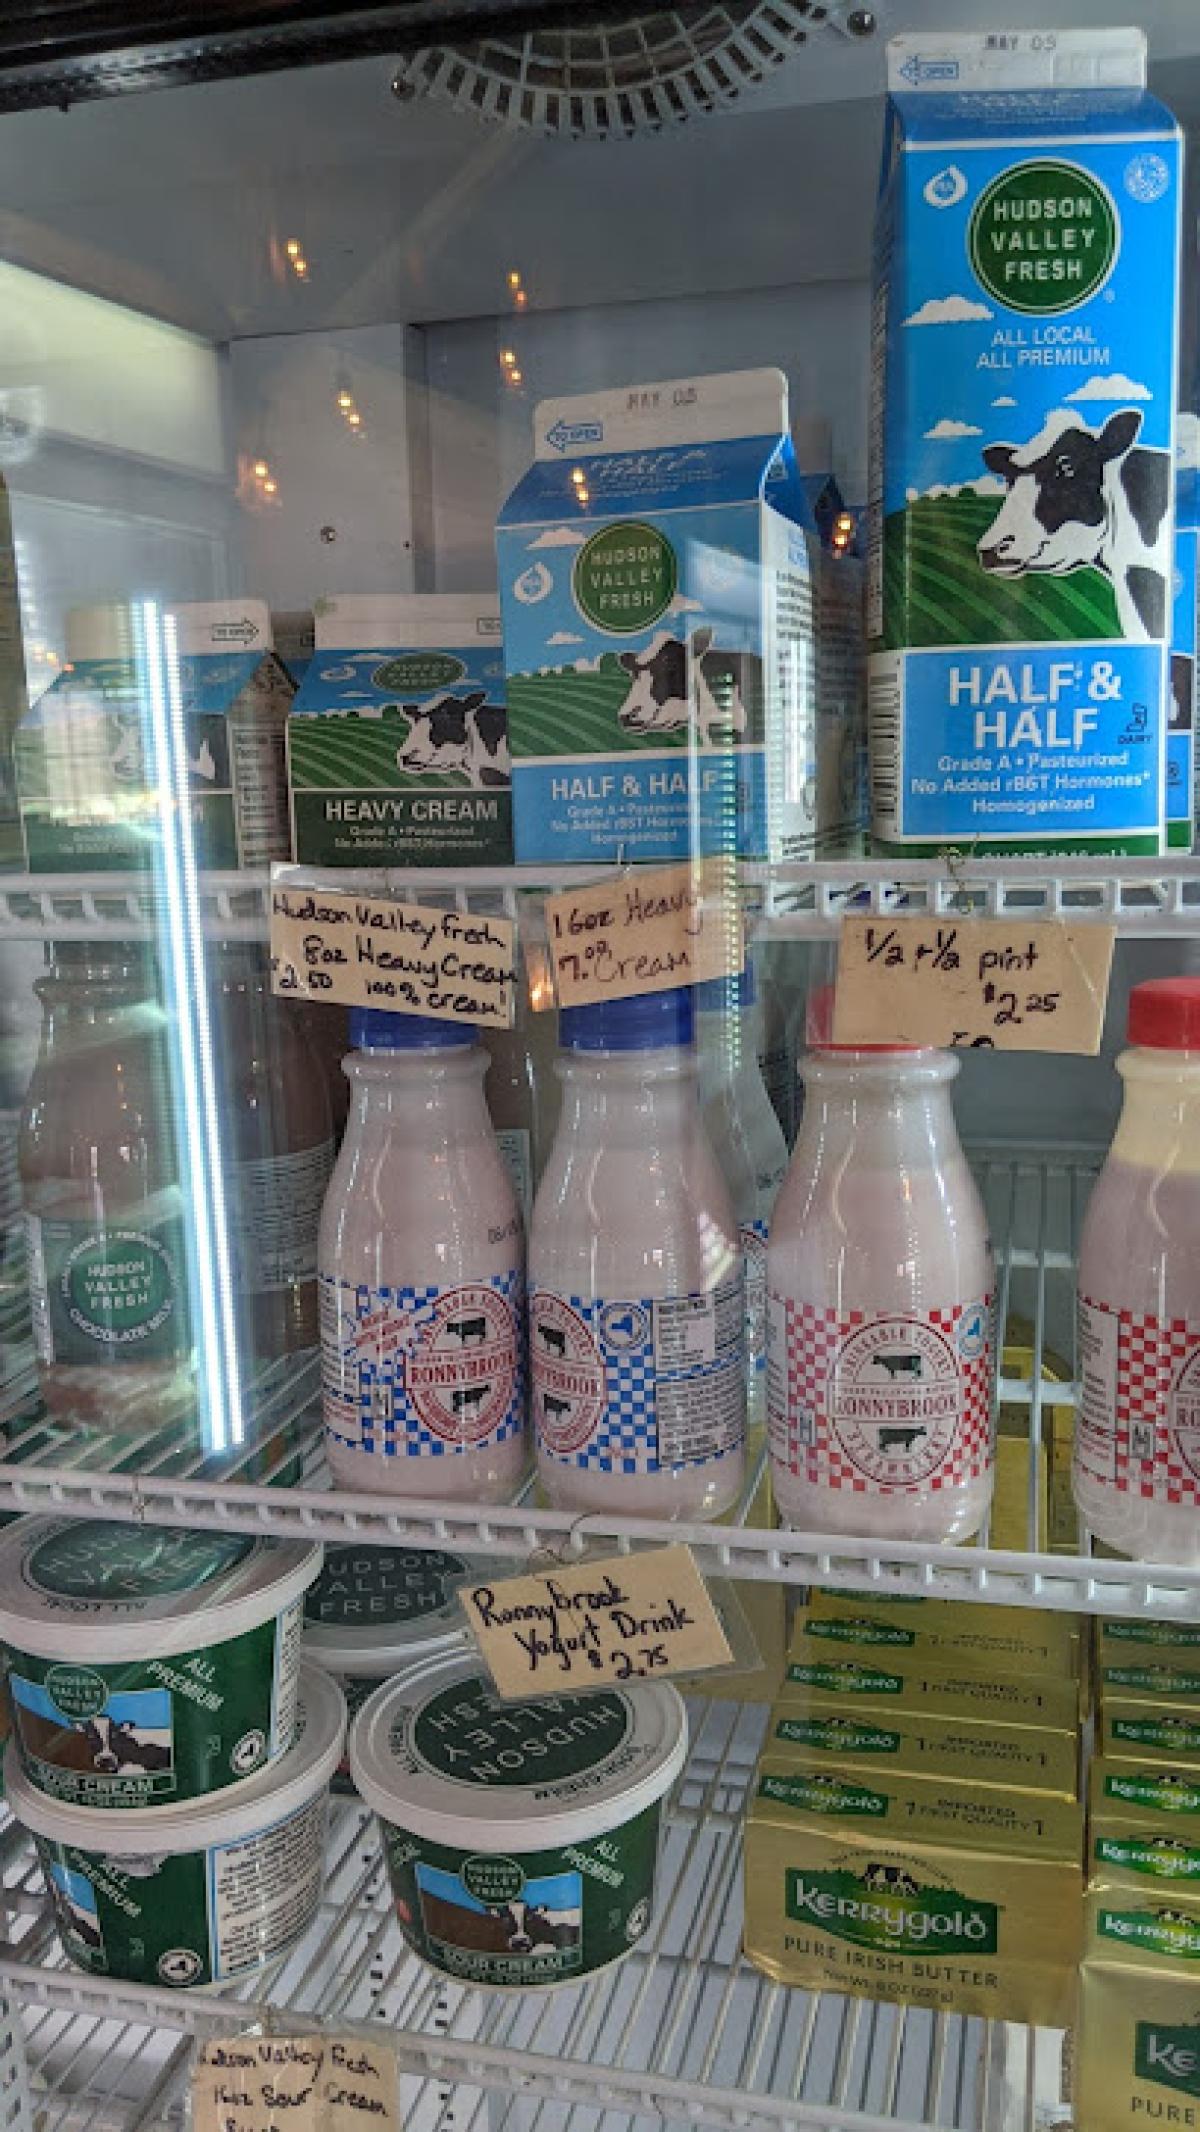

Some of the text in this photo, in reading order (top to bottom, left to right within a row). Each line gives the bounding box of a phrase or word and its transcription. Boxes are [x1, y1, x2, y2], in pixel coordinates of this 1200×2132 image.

[992, 197, 1093, 222] HUDSON
[990, 229, 1097, 252] VALLEY
[1004, 258, 1084, 283] FRESH
[991, 326, 1098, 346] ALL LOCAL
[975, 348, 1111, 370] ALL PREMIUM
[590, 546, 662, 567] HUDSON
[589, 568, 663, 587] VALLEY
[599, 591, 654, 609] FRESH
[948, 661, 1122, 706] HALF &
[973, 707, 1099, 750] HALF
[937, 752, 1129, 773] Grade A Pasteurized
[552, 774, 616, 801] HALF
[622, 773, 641, 796] &
[911, 778, 937, 795] No
[943, 777, 1001, 793] Added
[325, 799, 498, 821] HEAVY CREAM
[972, 795, 1095, 815] Homogenized
[272, 893, 354, 924] Hudson
[355, 903, 437, 950] Valley
[355, 935, 439, 989] Heavy
[440, 953, 519, 986] Cream
[593, 951, 692, 983] Cream
[978, 941, 1039, 981] pint
[87, 1260, 146, 1278] HUDSON
[84, 1275, 151, 1294] VALLEY
[90, 1292, 149, 1310] FRESH
[328, 1554, 446, 1577] UDSON
[319, 1591, 437, 1616] FRESH
[608, 1598, 695, 1639] Drink
[183, 1657, 216, 1684] ALL
[146, 1659, 225, 1713] PREMIUM
[470, 1703, 620, 1783] HUDSON
[561, 1846, 625, 1889] PREMIUM
[784, 1934, 998, 1989] PURE IRISH BUTTER
[1131, 2095, 1196, 2127] PURE
